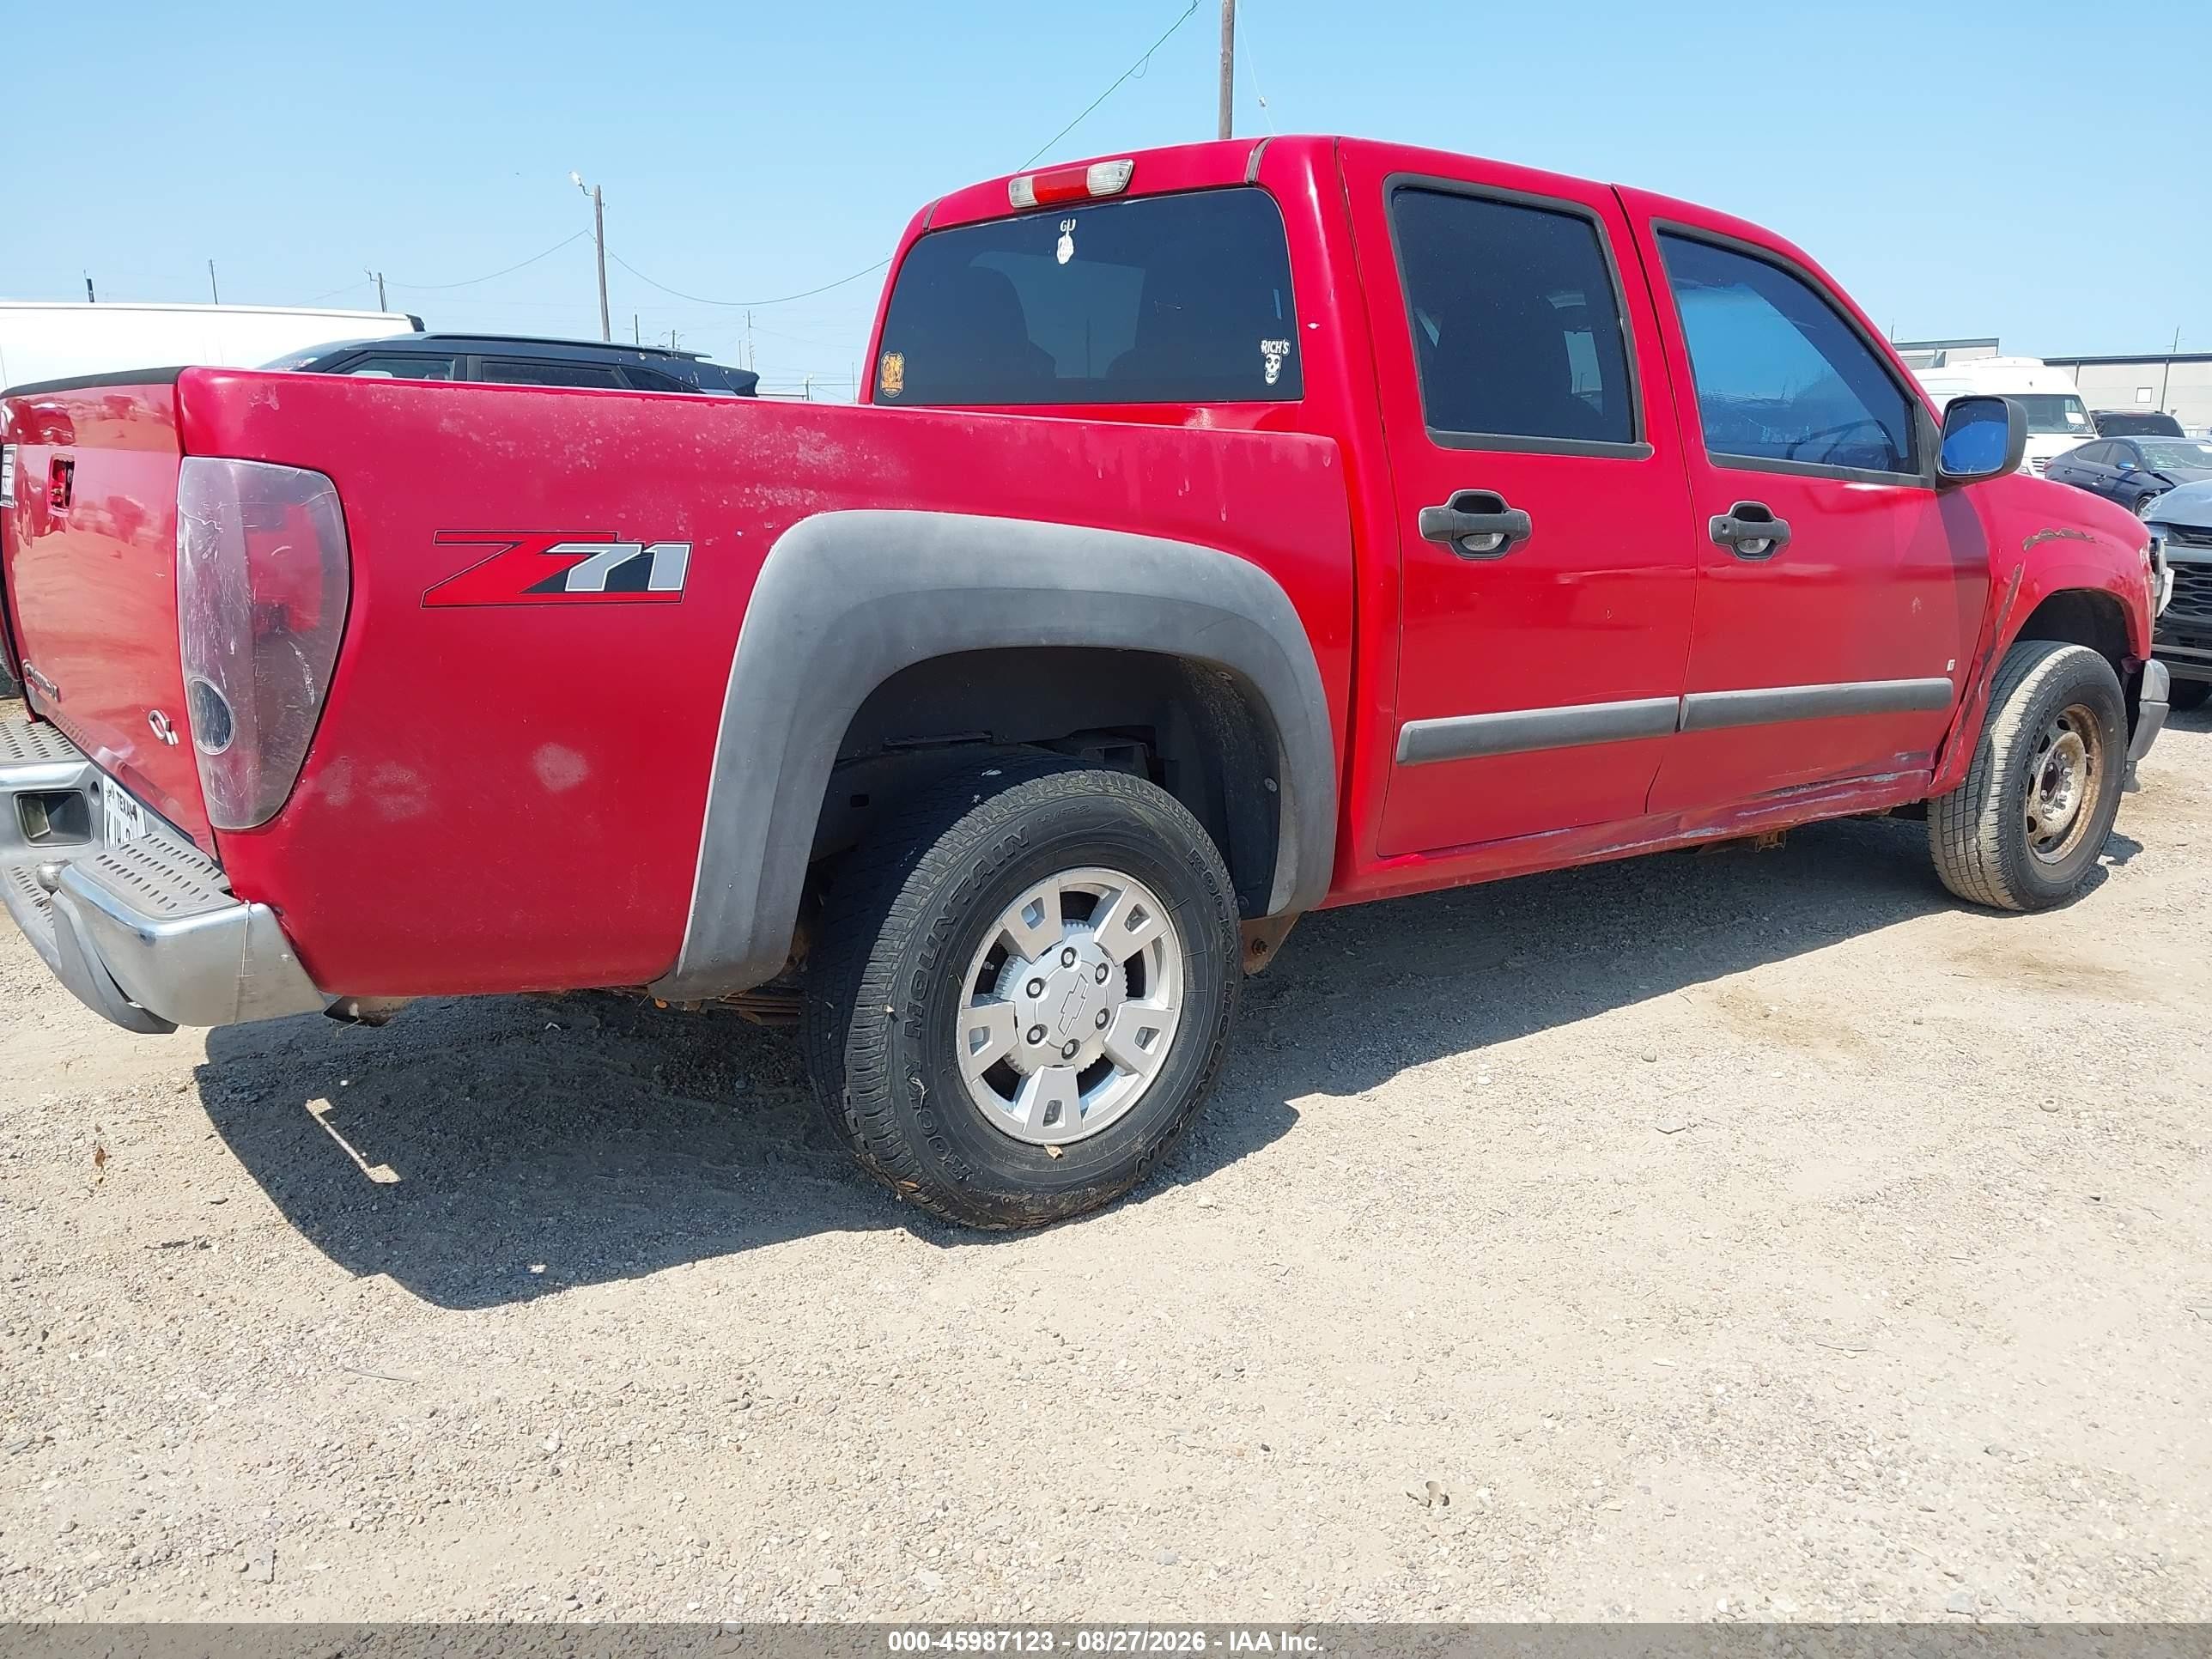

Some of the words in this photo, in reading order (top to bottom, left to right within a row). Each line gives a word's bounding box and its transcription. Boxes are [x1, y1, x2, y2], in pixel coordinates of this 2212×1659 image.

[1261, 338, 1290, 355] RICH'S
[421, 530, 692, 609] Z71
[903, 824, 1030, 1040] MOUNTAIN
[903, 1050, 976, 1181] ROCKY
